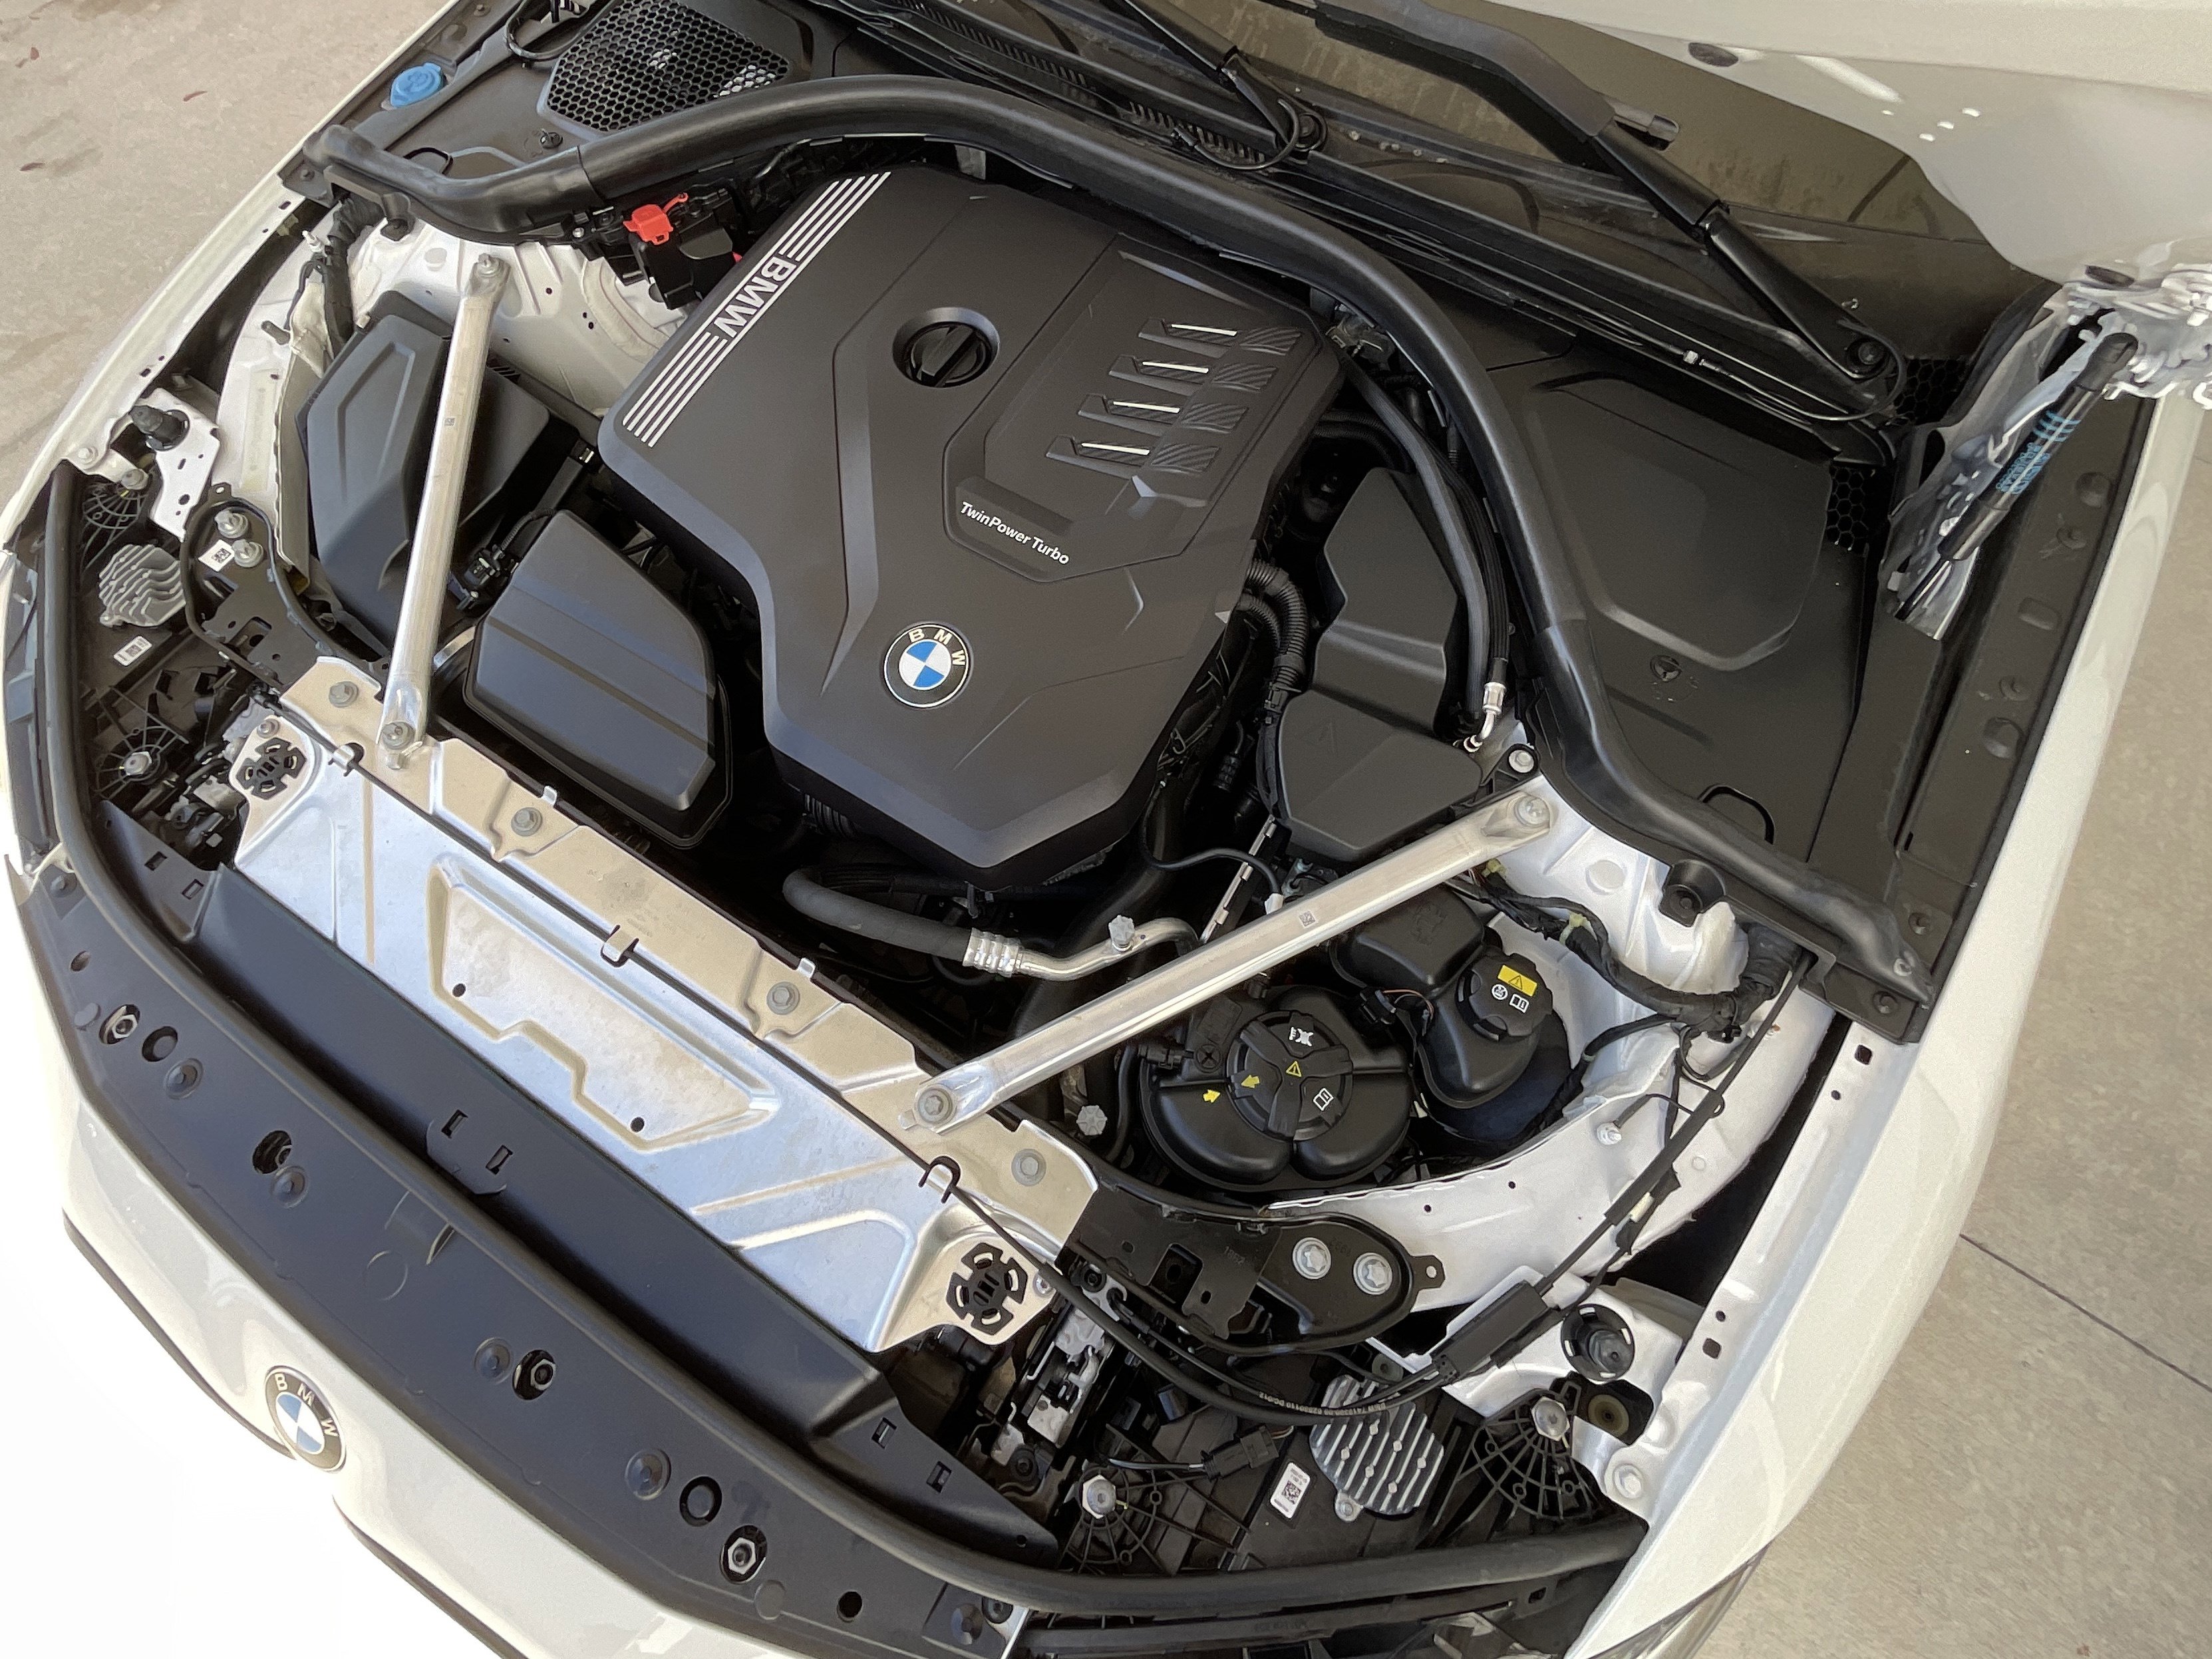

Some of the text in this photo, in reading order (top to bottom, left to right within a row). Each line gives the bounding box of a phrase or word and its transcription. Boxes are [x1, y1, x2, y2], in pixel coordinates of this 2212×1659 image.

[714, 257, 797, 338] BMW
[960, 501, 1070, 565] TwinPower Turbo
[908, 628, 965, 666] BMW
[275, 1373, 339, 1437] BMW
